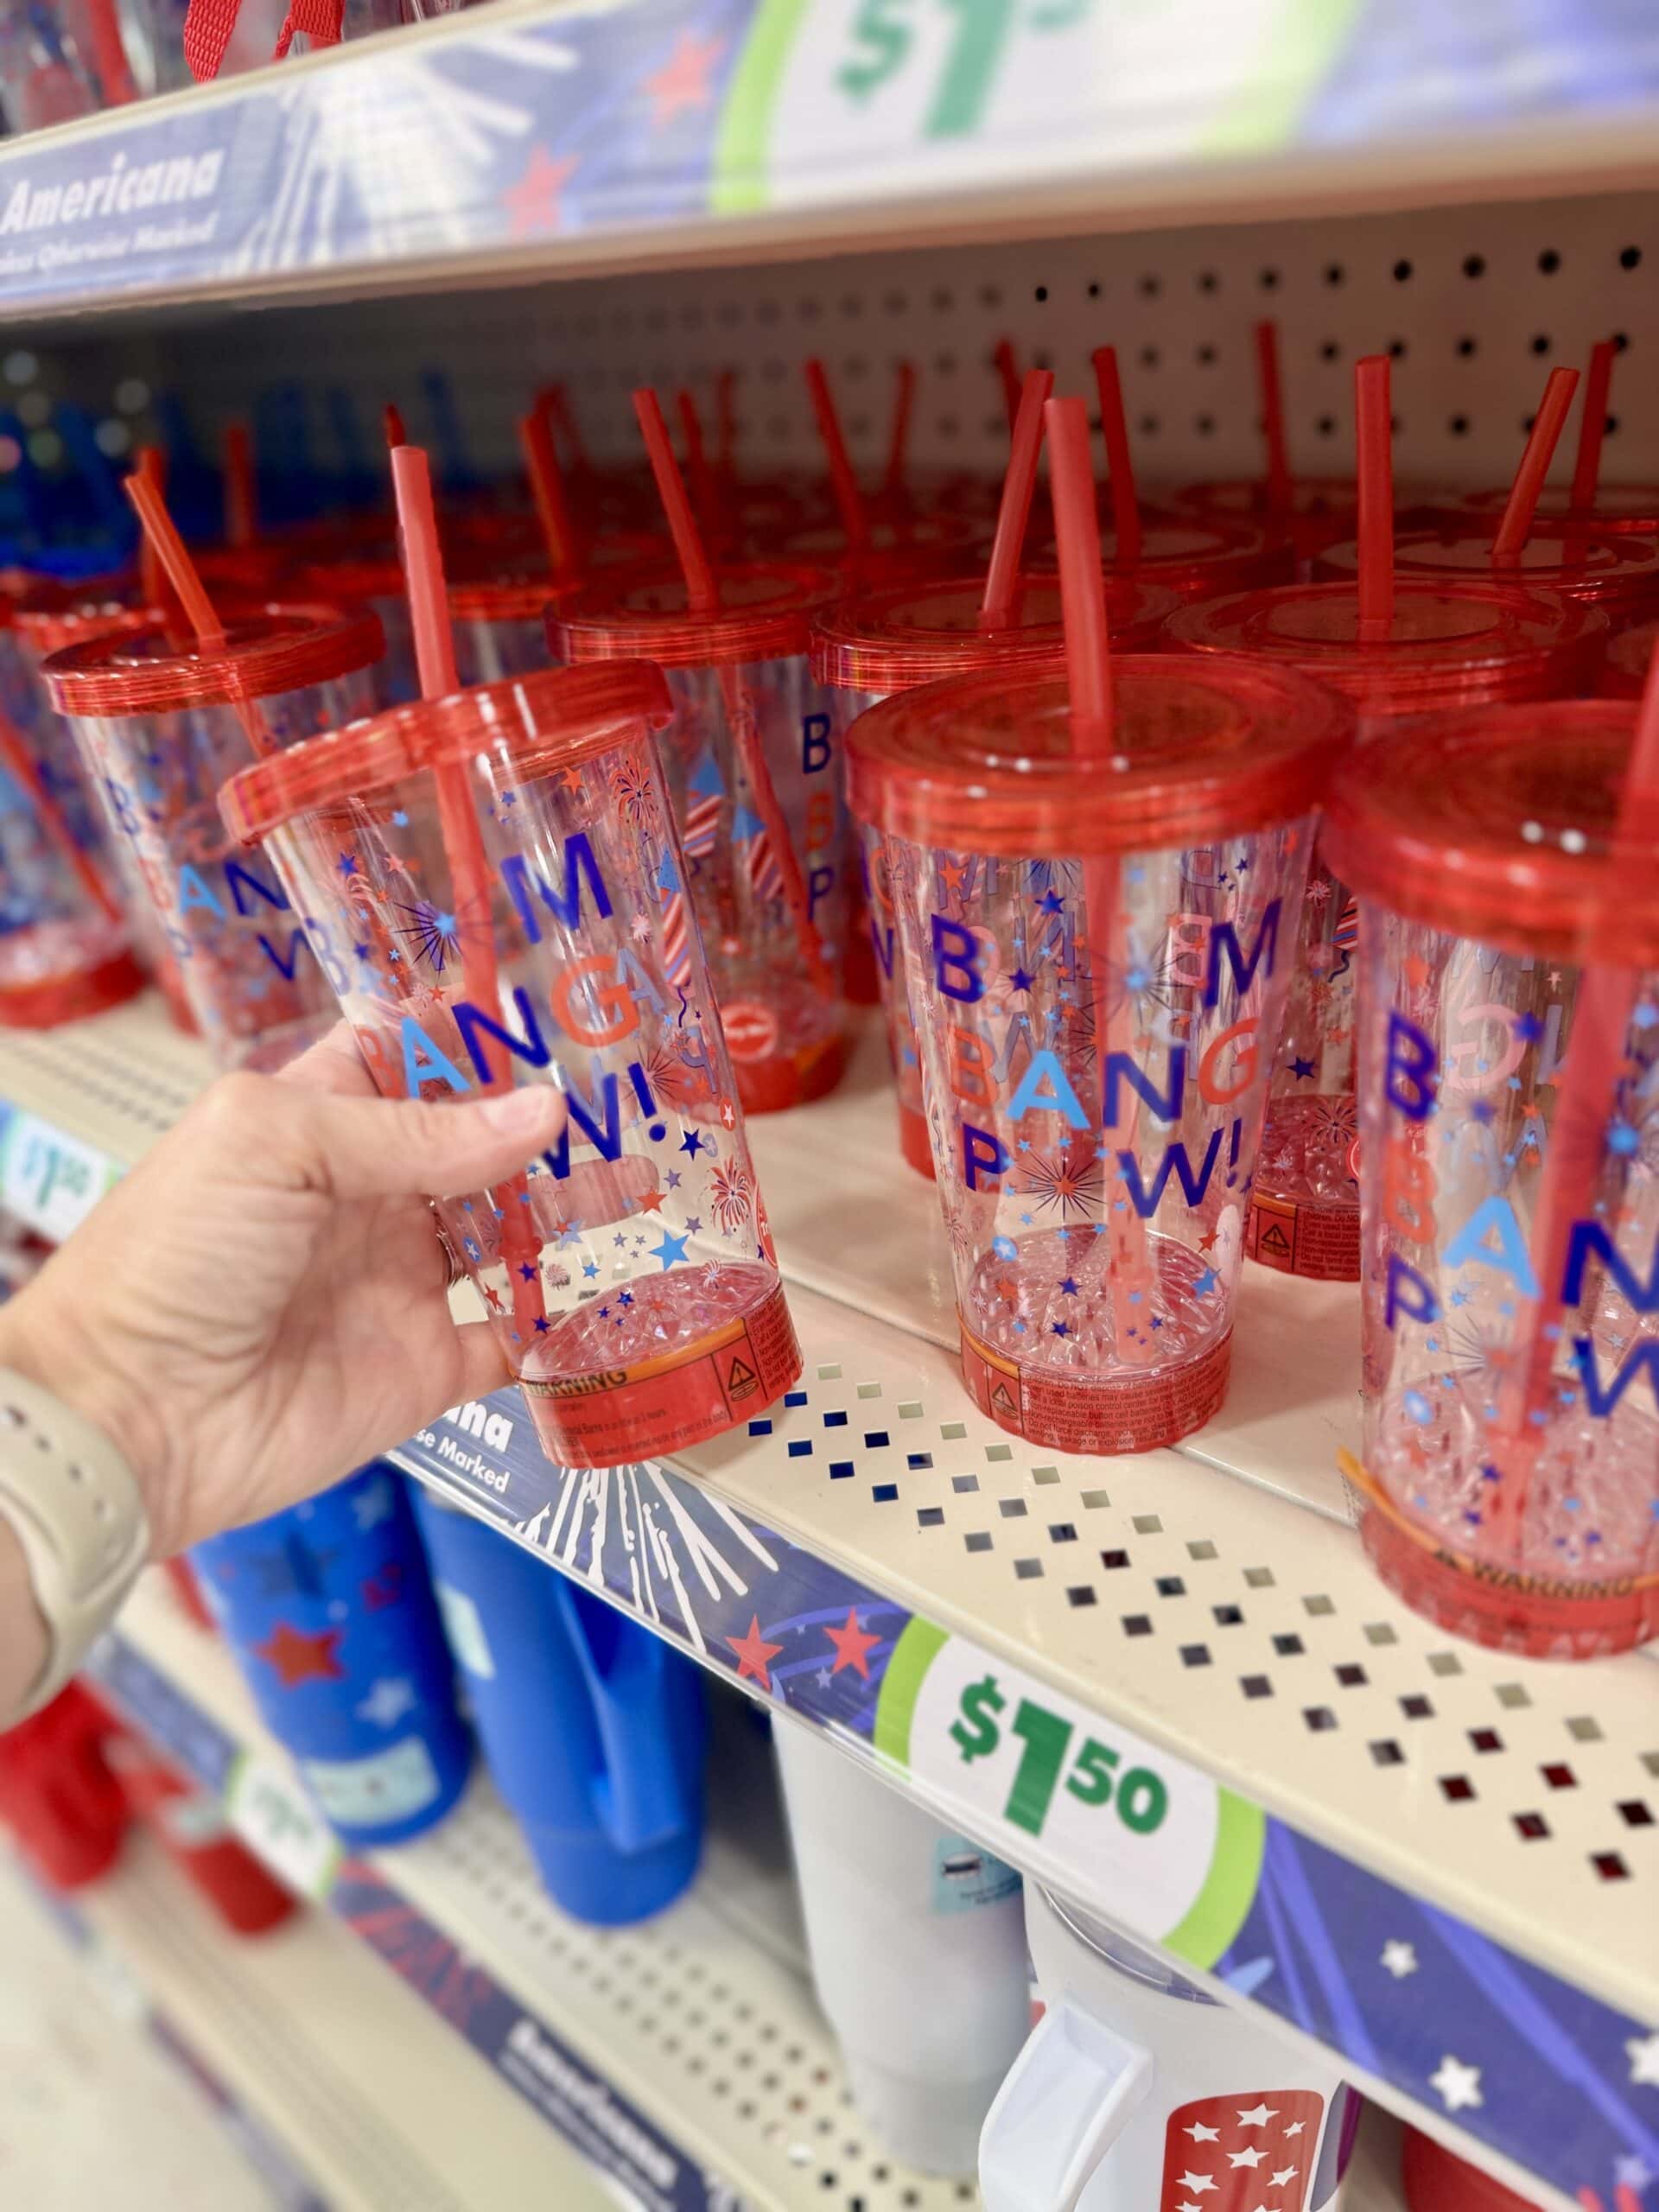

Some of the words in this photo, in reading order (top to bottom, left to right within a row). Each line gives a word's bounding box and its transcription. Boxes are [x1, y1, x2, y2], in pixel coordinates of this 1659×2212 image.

[0, 149, 225, 234] Americana
[950, 1016, 1261, 1130] BANG
[437, 1436, 511, 1493] Marked
